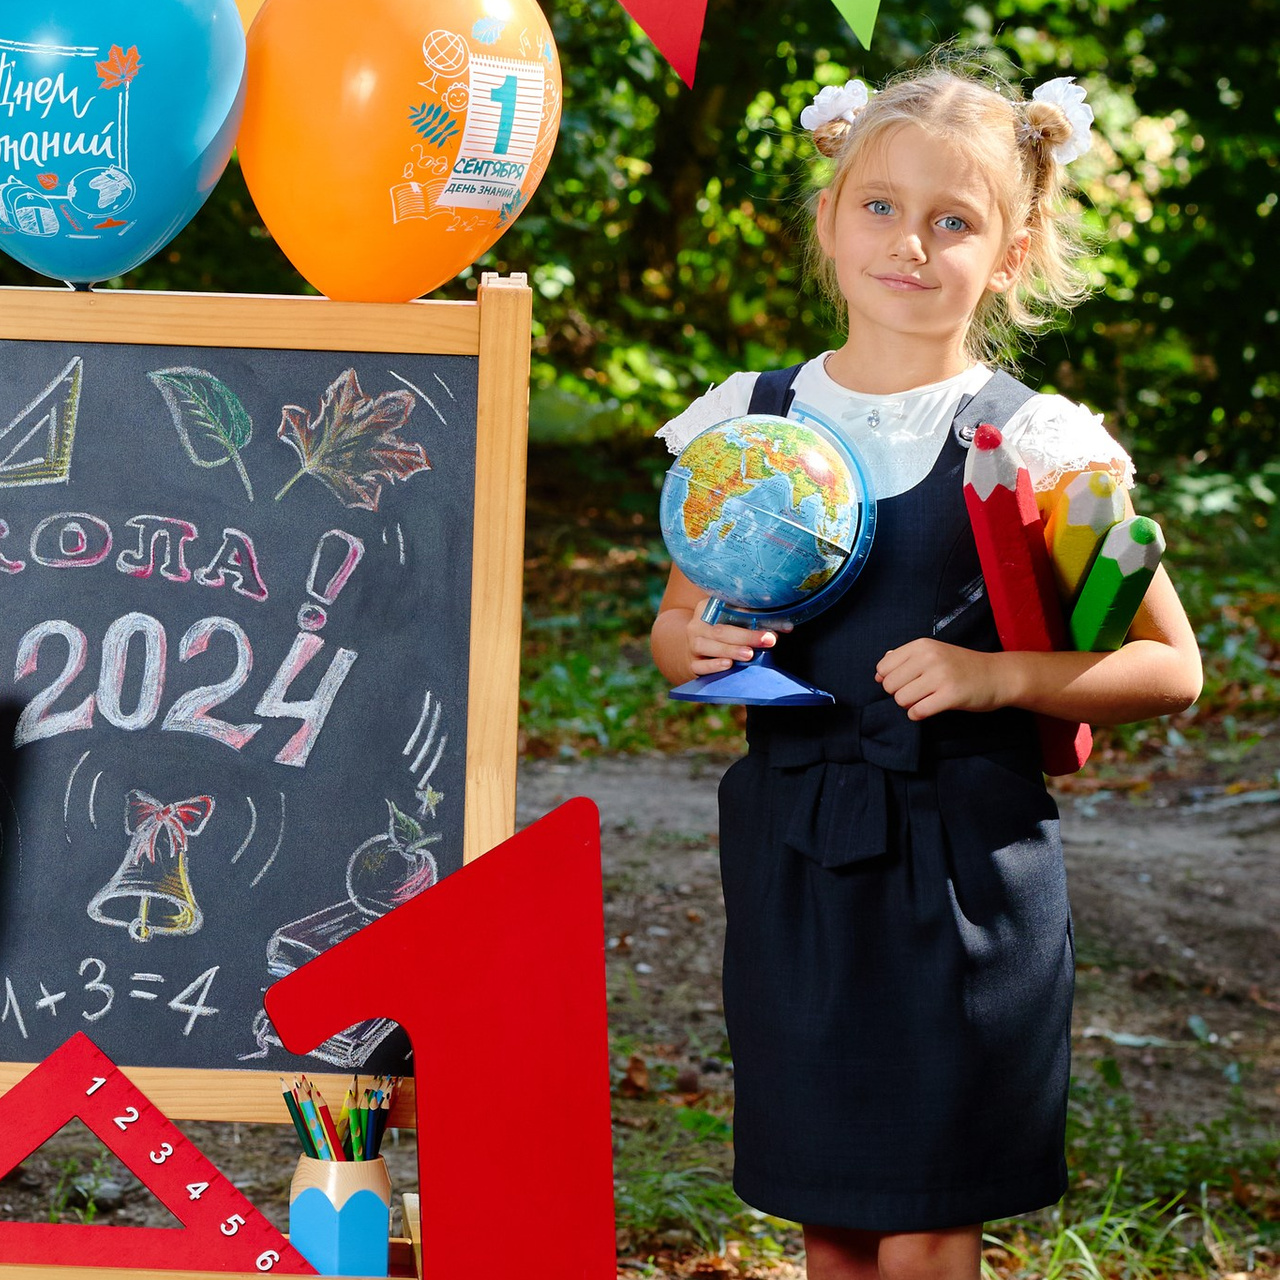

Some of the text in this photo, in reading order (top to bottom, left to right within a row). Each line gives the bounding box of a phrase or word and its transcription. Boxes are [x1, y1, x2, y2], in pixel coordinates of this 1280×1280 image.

[490, 75, 518, 156] 1
[444, 183, 515, 199] ДЕНЬ ЗНАНИЙ
[452, 157, 526, 181] СЕНТЯБРЯ
[12, 611, 360, 768] 2024
[85, 1076, 281, 1271] 1 2 3 4 5 6
